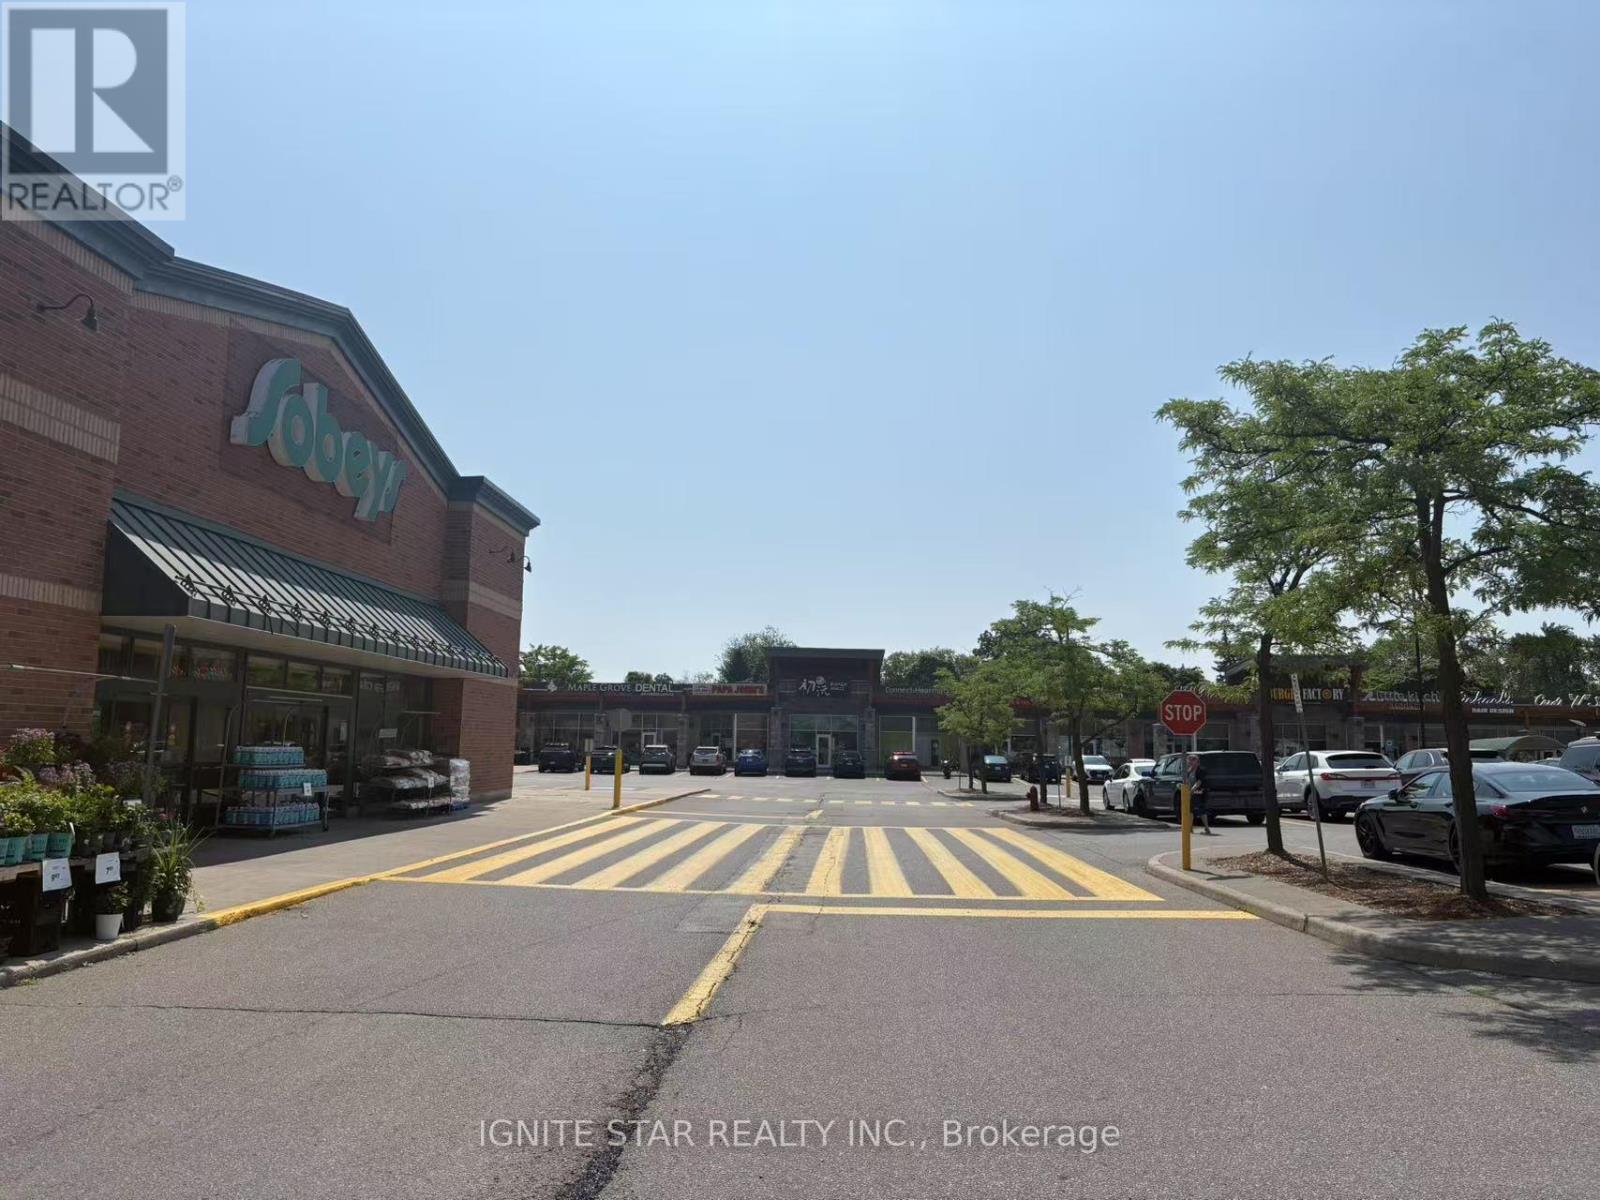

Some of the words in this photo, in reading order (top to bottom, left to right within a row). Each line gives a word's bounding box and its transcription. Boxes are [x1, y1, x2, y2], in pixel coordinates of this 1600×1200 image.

[599, 683, 632, 692] GROVE
[635, 683, 673, 692] DENTAL
[1164, 704, 1203, 721] STOP
